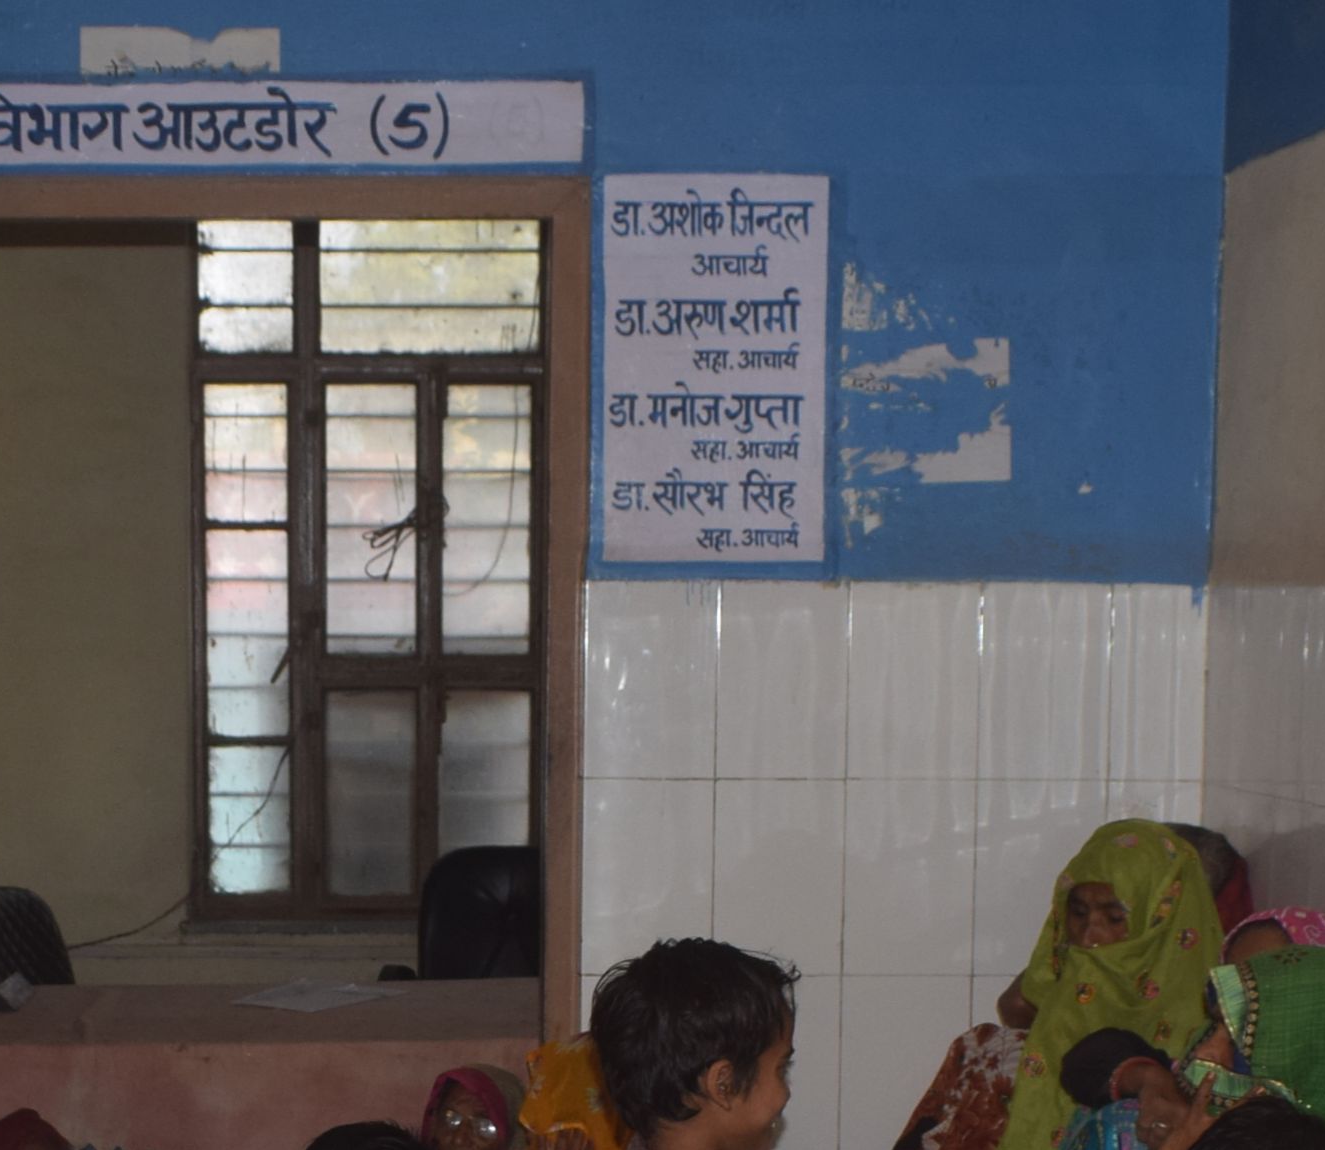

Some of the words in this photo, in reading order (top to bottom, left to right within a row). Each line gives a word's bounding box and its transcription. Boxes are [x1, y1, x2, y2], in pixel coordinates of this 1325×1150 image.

[132, 86, 337, 158] आउटडोर
[370, 91, 449, 160] (5)
[726, 187, 814, 243] जिन्दल
[691, 244, 769, 277] आचार्य
[730, 287, 801, 336] शर्मा
[738, 342, 800, 370] आचार्य
[725, 394, 803, 433] गुप्ता
[736, 433, 800, 460] आचार्य
[740, 469, 796, 519] सिंह
[742, 522, 800, 548] आचार्य
